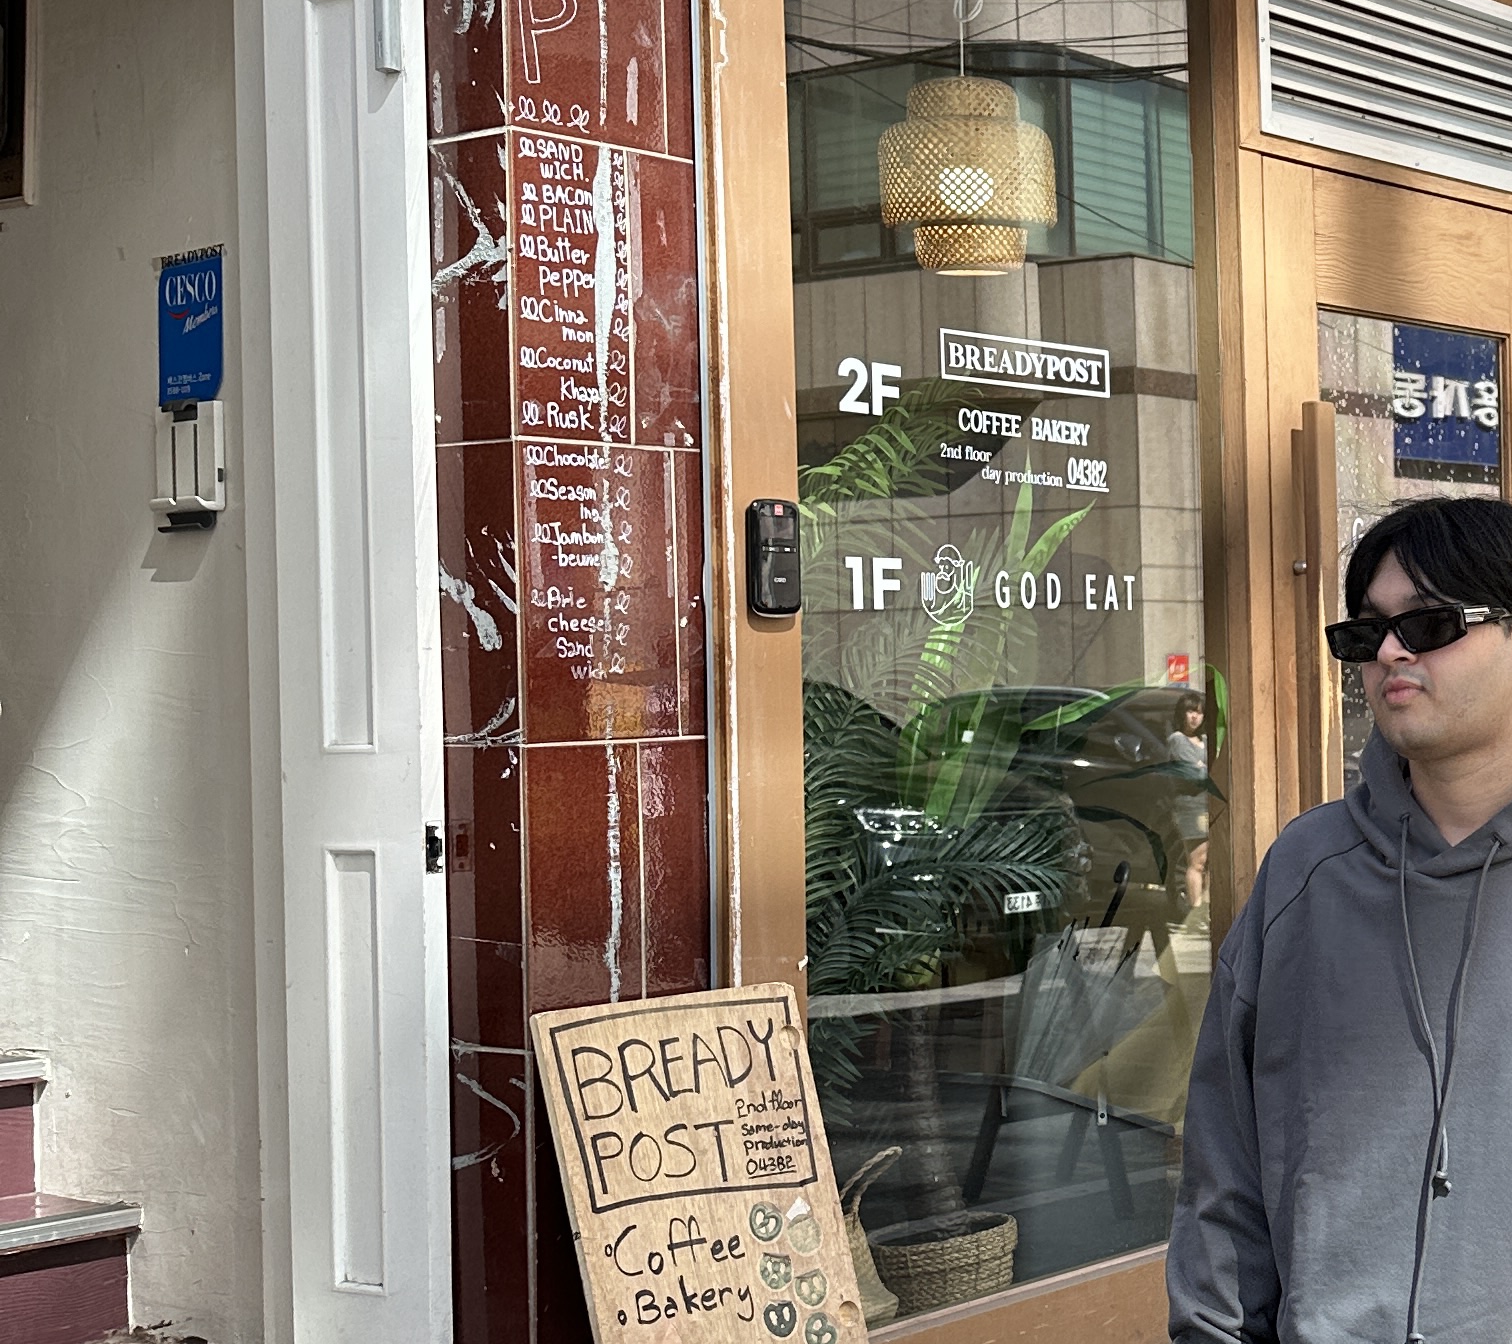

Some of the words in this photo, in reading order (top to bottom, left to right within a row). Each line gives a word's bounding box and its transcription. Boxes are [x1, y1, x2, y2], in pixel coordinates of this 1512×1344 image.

[536, 139, 583, 163] SAND
[539, 205, 594, 235] PLAIN
[161, 244, 224, 270] BREADYPOST
[537, 236, 590, 265] Butter
[165, 270, 216, 306] CESCO
[182, 303, 218, 335] Members
[538, 299, 588, 324] Cinna
[562, 326, 594, 343] mon
[536, 347, 594, 373] Coconut
[837, 357, 902, 416] 2F
[948, 341, 1102, 386] BREADYPOST
[547, 402, 594, 431] Rusk
[958, 408, 1022, 439] COFFEE
[1031, 417, 1090, 447] BAKERY
[940, 442, 962, 461] 2nd
[965, 445, 992, 463] floor
[981, 465, 1001, 485] day
[1004, 468, 1063, 488] production
[1067, 457, 1108, 488] 04382
[547, 478, 597, 501] Season
[549, 522, 604, 546] Jambon
[844, 556, 903, 611] 1F
[547, 586, 588, 609] Brie
[548, 612, 605, 632] cheese
[556, 635, 594, 658] Sand
[571, 661, 607, 680] wich
[571, 1018, 776, 1121] BREADY
[768, 1089, 802, 1112] floor
[590, 1119, 734, 1195] POST
[743, 1135, 808, 1156] production
[746, 1155, 796, 1175] 04382
[613, 1214, 746, 1277] Coffee
[635, 1276, 755, 1326] Bakery
